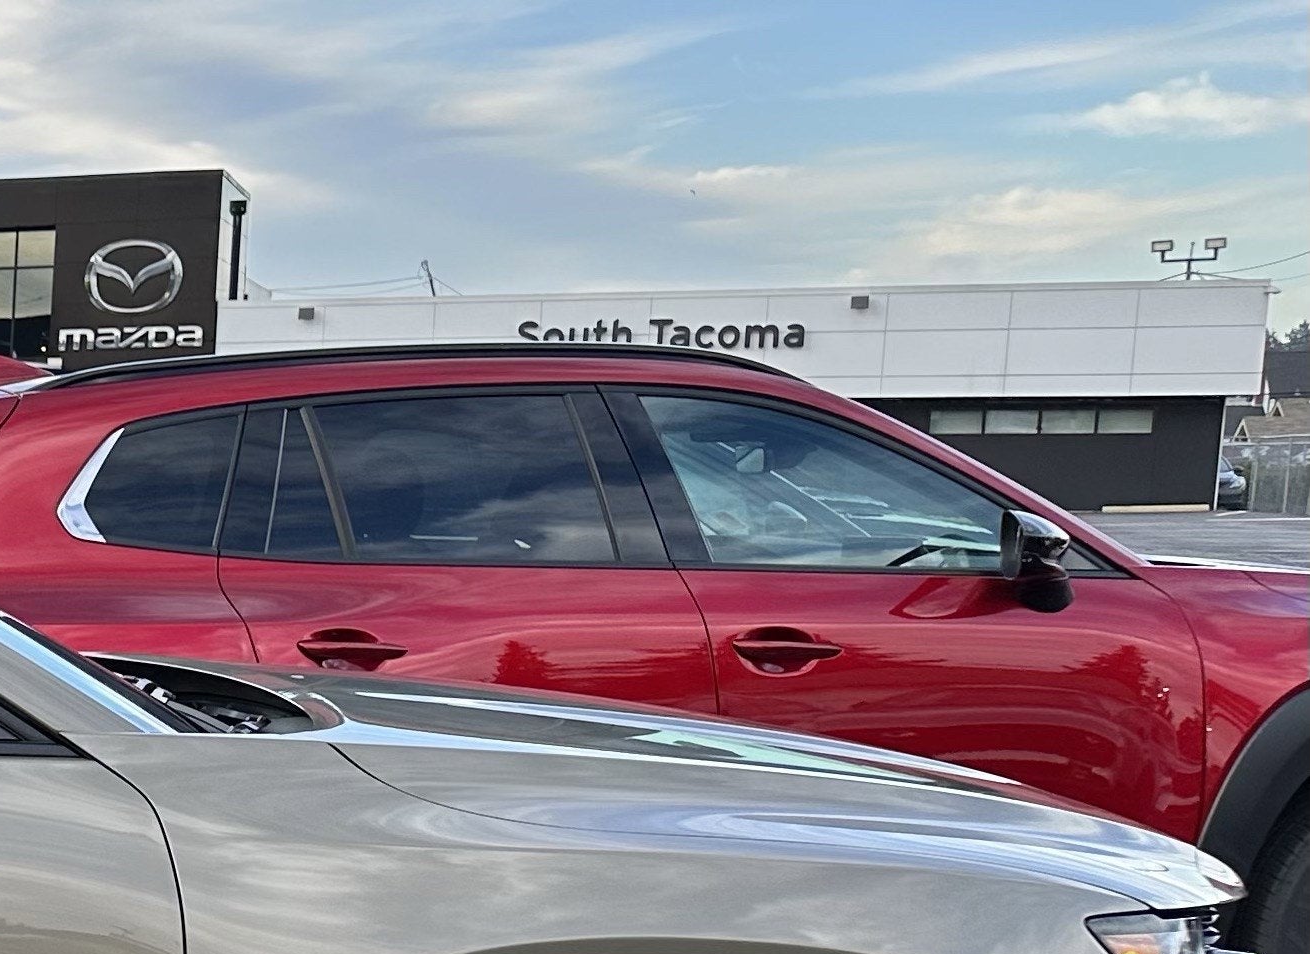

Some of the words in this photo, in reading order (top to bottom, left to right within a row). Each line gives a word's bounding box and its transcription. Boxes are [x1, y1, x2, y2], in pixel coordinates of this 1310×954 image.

[58, 325, 203, 350] mazda
[518, 319, 631, 343] South
[649, 318, 804, 348] Tacoma
